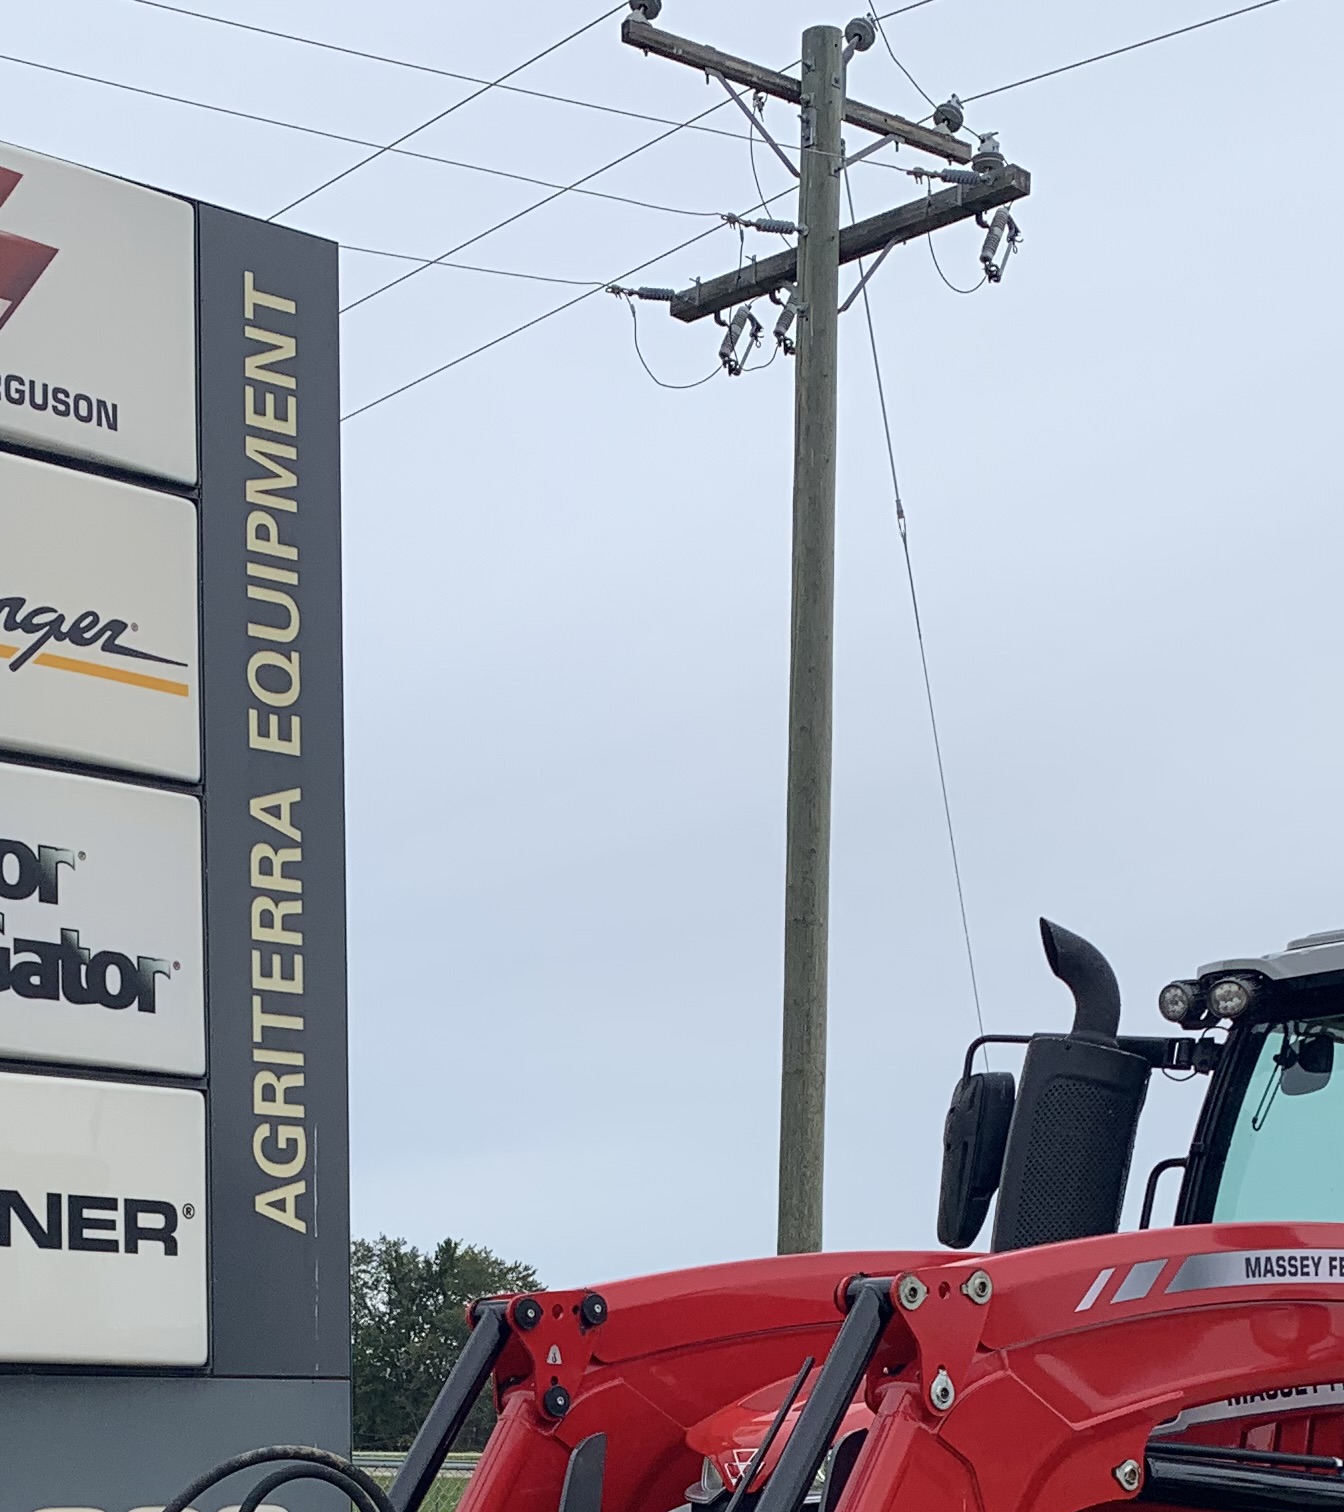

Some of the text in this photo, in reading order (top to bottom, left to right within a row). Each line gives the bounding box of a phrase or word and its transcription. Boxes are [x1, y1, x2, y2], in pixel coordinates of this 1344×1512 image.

[244, 270, 310, 1235] AGRITERRA EQUIPMENT
[1244, 1254, 1322, 1282] MASSEY
